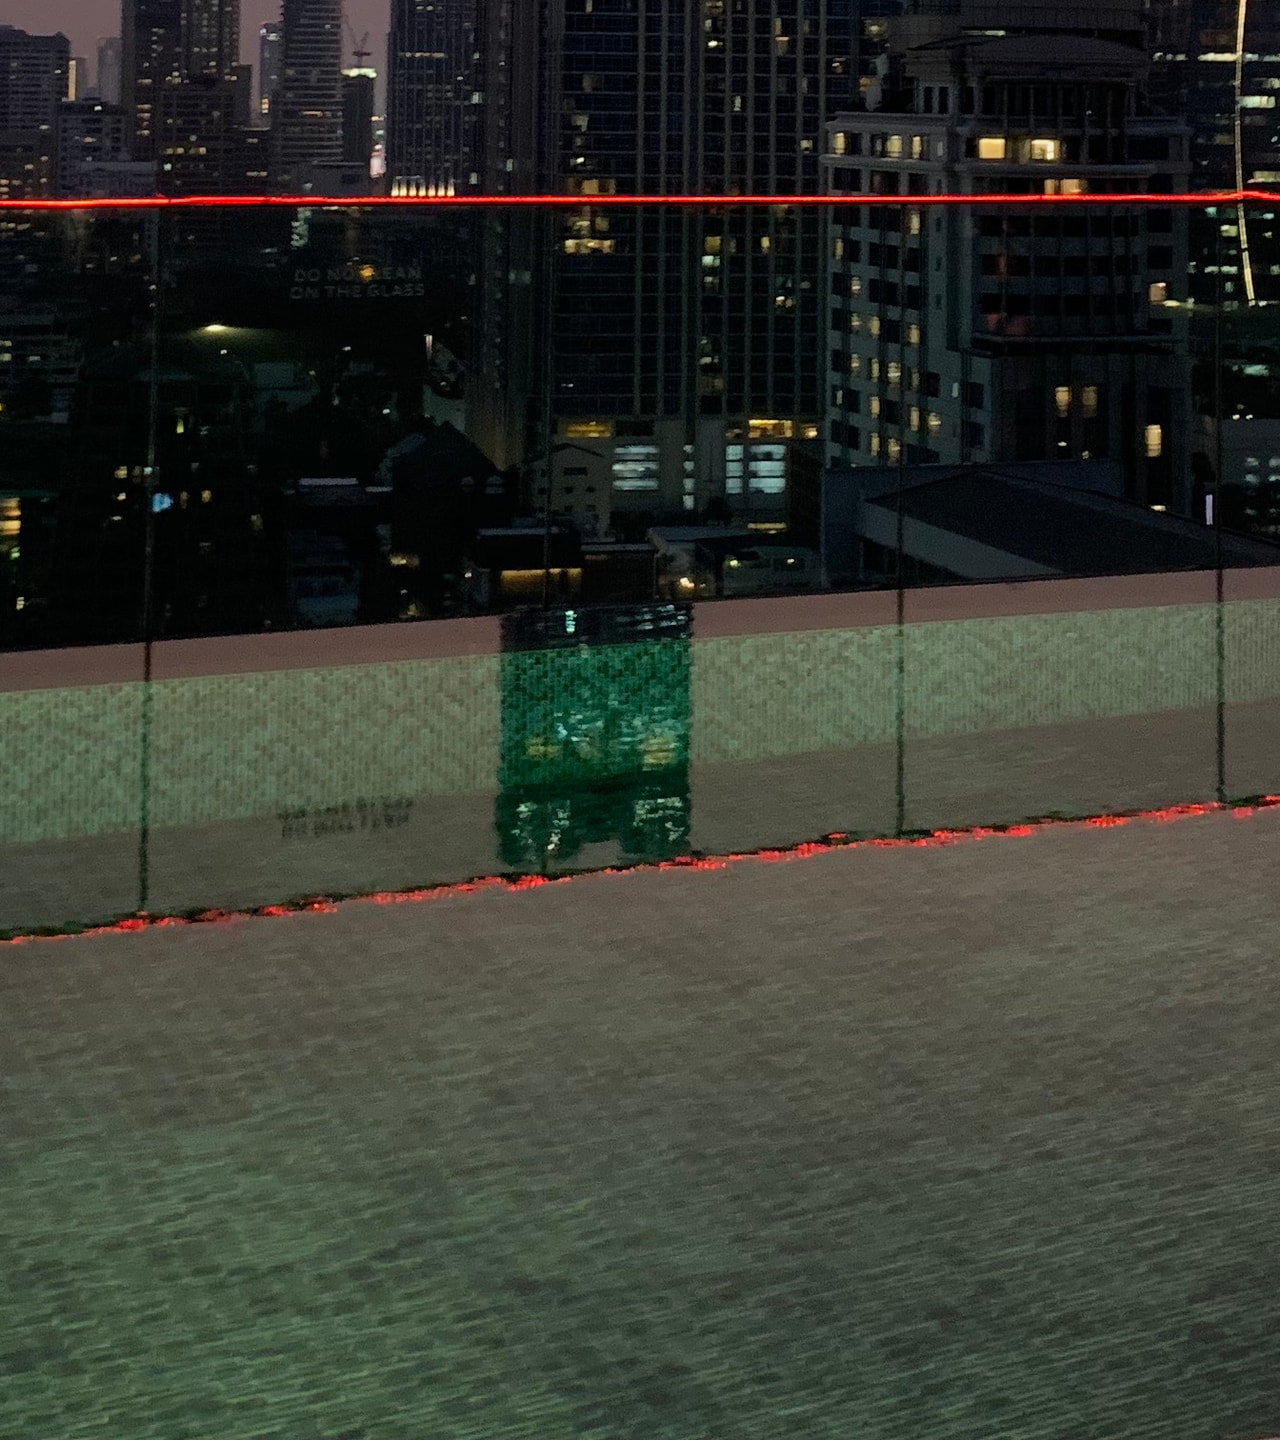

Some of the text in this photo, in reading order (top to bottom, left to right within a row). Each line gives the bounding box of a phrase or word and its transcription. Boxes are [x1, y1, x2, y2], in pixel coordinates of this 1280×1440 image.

[294, 268, 321, 282] DO
[289, 283, 425, 300] ON THE GLASS
